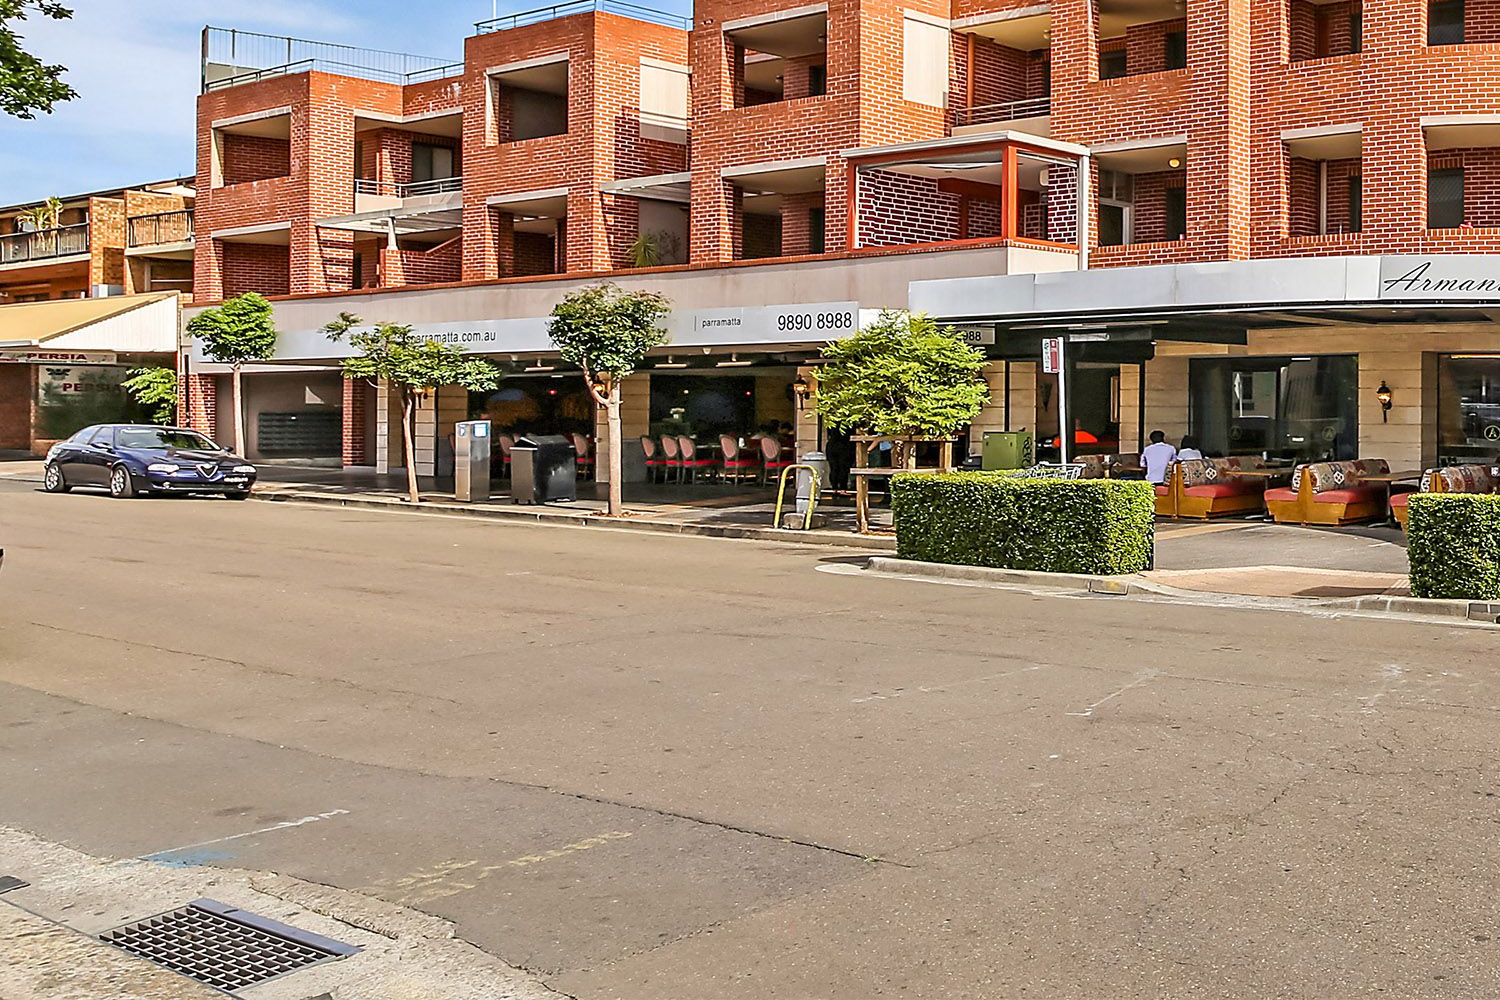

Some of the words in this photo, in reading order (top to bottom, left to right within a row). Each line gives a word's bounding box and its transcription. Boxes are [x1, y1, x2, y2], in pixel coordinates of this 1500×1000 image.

[702, 318, 741, 328] parramatta
[777, 313, 812, 331] 9890
[816, 312, 852, 329] 8988
